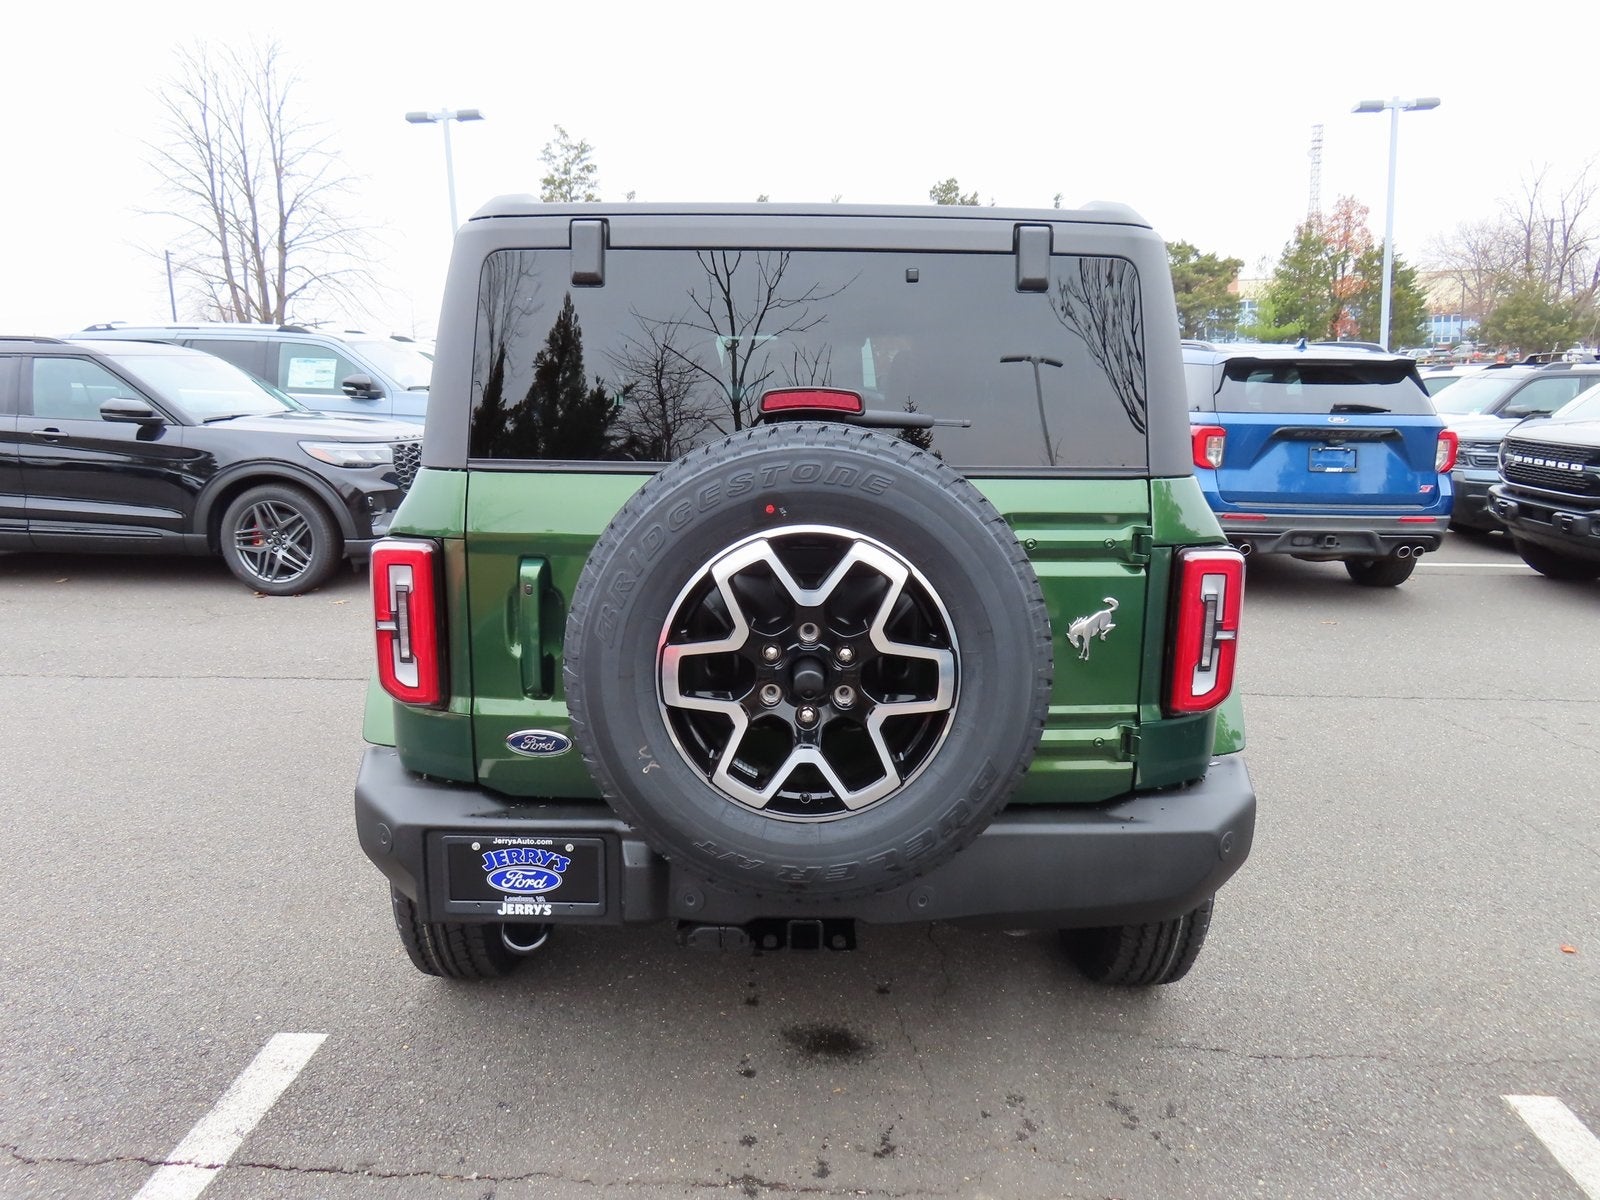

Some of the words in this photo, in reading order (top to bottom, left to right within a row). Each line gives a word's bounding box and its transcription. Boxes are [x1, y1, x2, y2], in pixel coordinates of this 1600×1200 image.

[1513, 455, 1583, 471] BRONCO
[594, 460, 896, 651] BRIDGESTONE
[520, 735, 556, 751] Ford
[776, 757, 999, 882] DUELER
[493, 837, 553, 846] JerrysAuto.com
[482, 848, 571, 873] JERRY'S
[693, 839, 765, 870] A/T
[501, 869, 548, 889] Ford
[497, 902, 552, 916] JERRY'S
